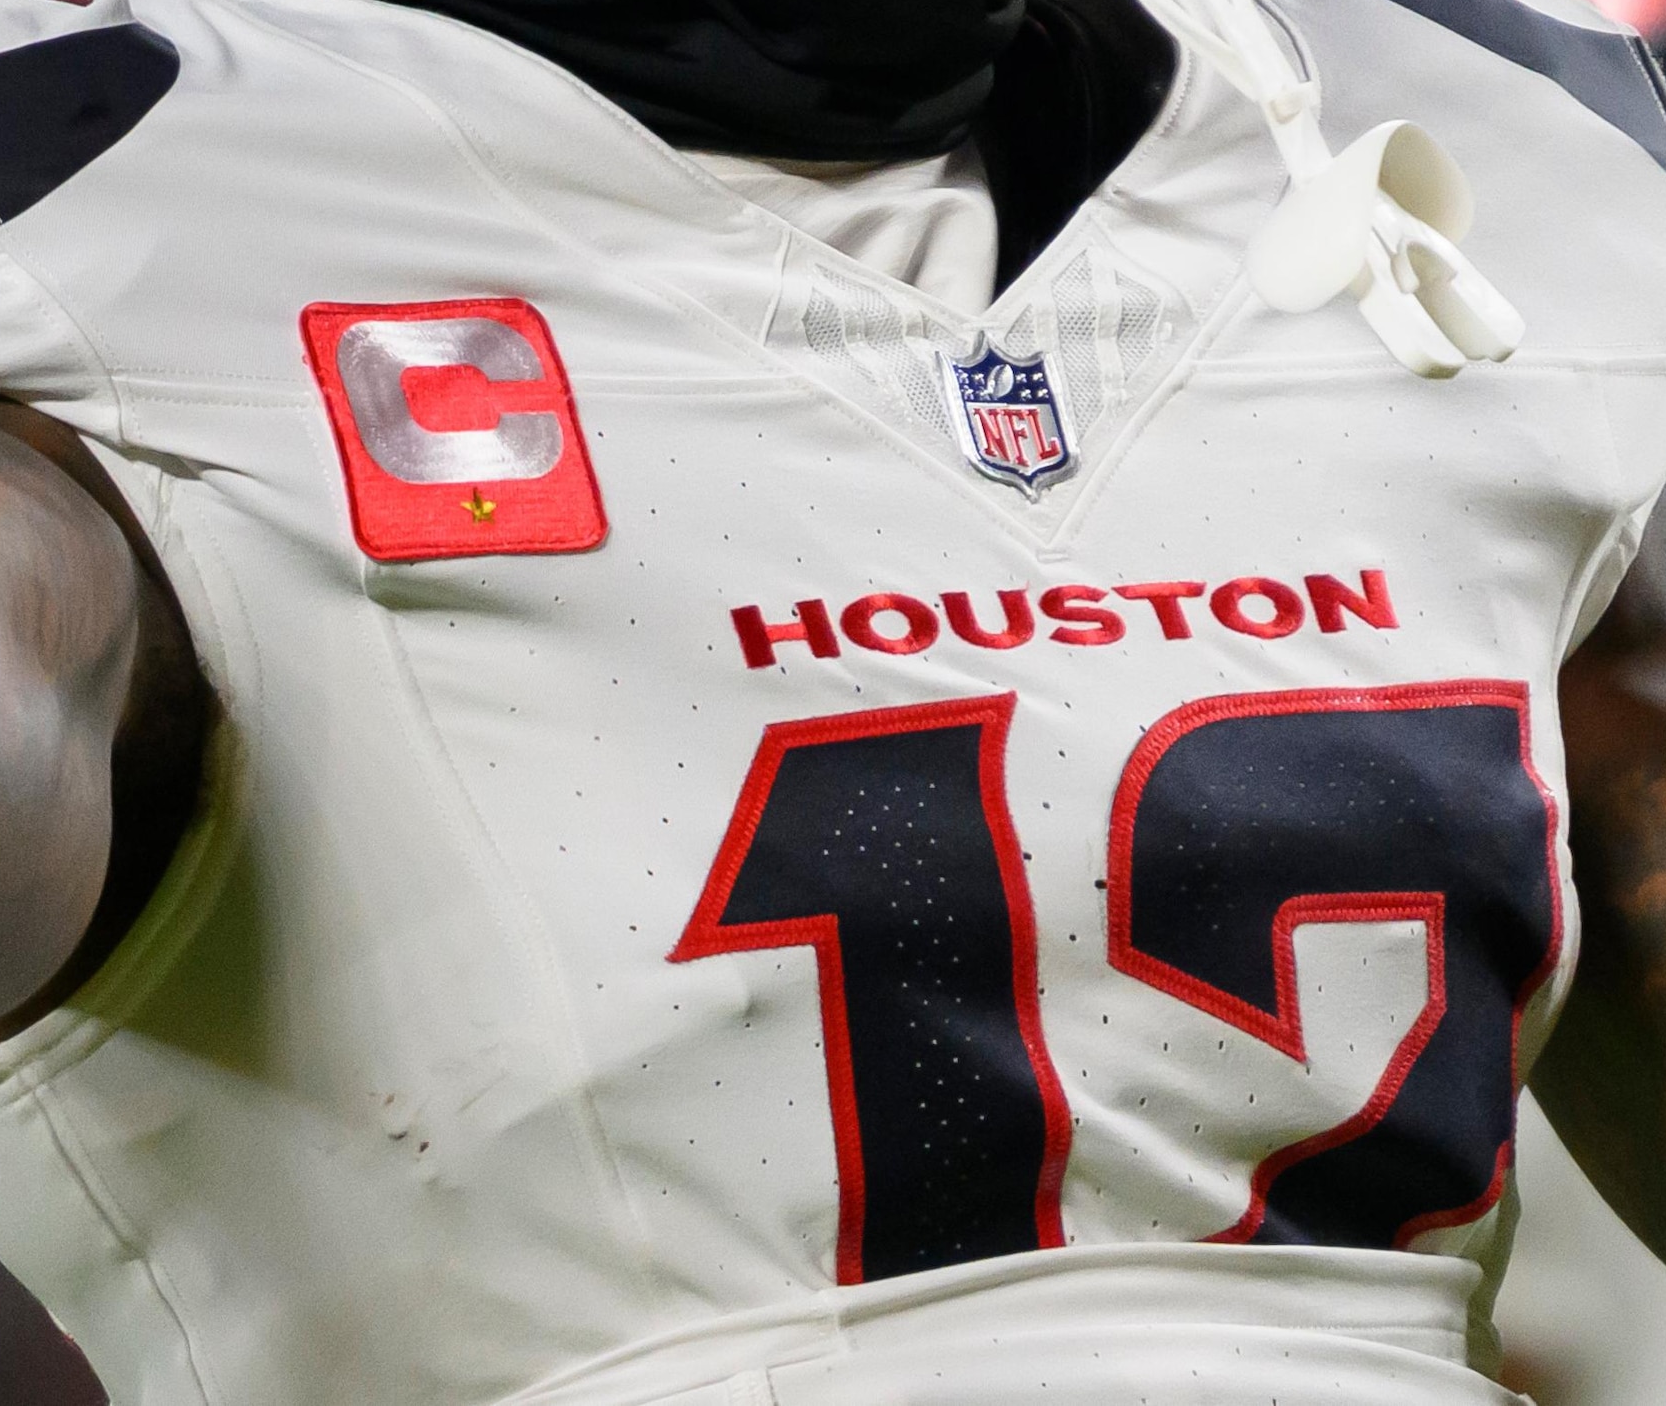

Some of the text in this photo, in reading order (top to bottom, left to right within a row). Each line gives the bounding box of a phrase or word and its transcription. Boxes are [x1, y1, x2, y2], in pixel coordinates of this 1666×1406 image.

[338, 317, 563, 484] C
[972, 407, 1061, 468] NFL
[732, 570, 1397, 669] HOUSTON
[667, 680, 1563, 1287] 12
